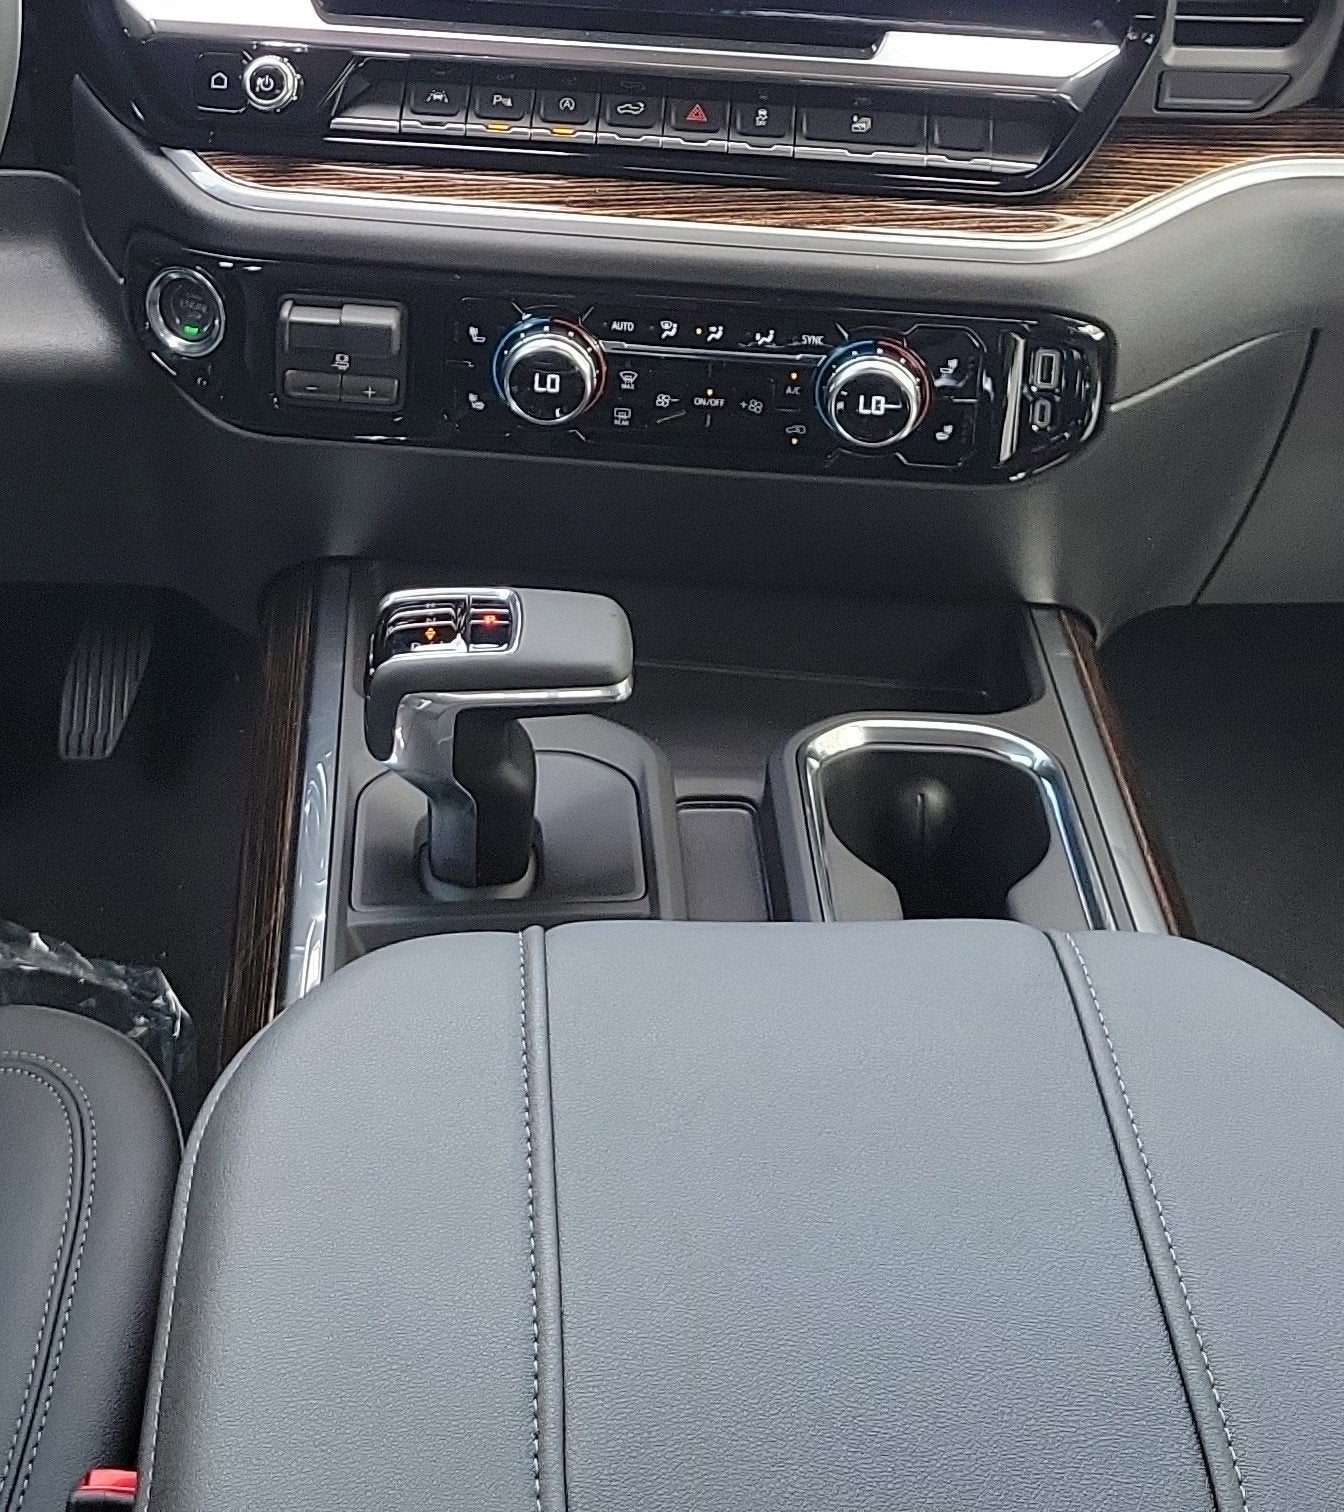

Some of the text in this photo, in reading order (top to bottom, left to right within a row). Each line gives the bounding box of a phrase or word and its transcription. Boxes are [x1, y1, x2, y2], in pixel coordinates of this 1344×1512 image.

[611, 321, 635, 332] AUTO
[801, 335, 825, 346] SYNC
[533, 372, 560, 394] LO
[785, 386, 802, 396] A/C
[693, 397, 726, 408] ON/OFF
